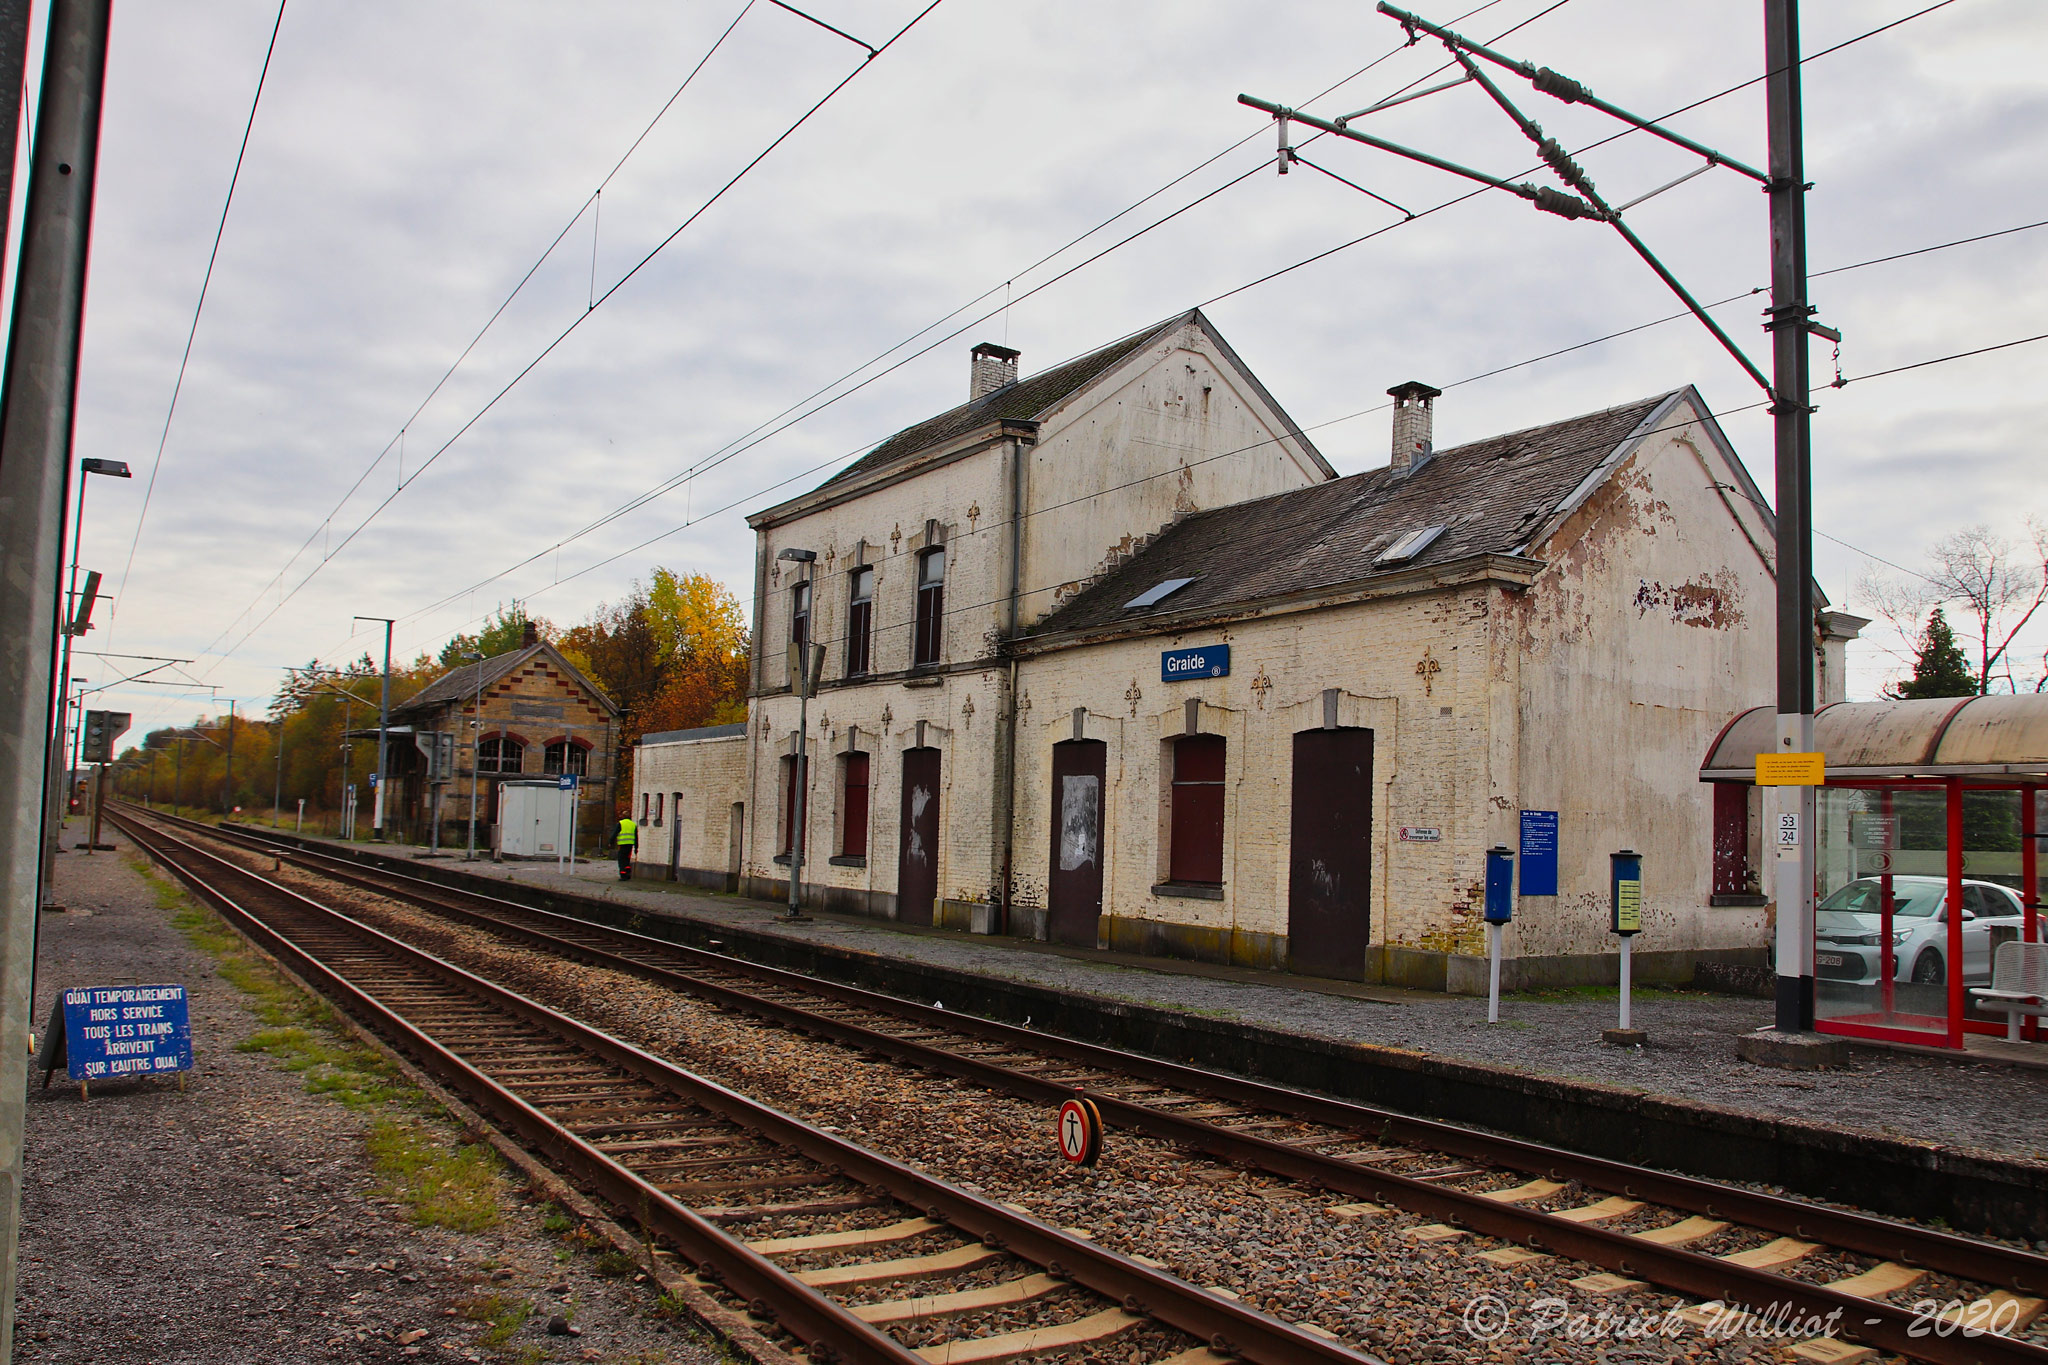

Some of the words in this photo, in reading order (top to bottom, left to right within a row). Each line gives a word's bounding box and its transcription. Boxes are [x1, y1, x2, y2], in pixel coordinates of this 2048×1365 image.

[1167, 653, 1205, 672] Graide
[1782, 816, 1795, 827] 53
[1782, 831, 1795, 842] 24
[1816, 956, 1841, 965] G-208
[66, 990, 91, 1005] QUAI
[94, 988, 183, 1004] TEMPORAIREMENT
[90, 1008, 118, 1021] HORS
[122, 1005, 164, 1020] SERVICE
[83, 1026, 111, 1040] TOUS
[115, 1024, 134, 1038] LES
[137, 1022, 174, 1036] TRAINS
[105, 1040, 155, 1056] ARRIVENT
[85, 1061, 106, 1076] SUR
[154, 1056, 178, 1069] QUAI
